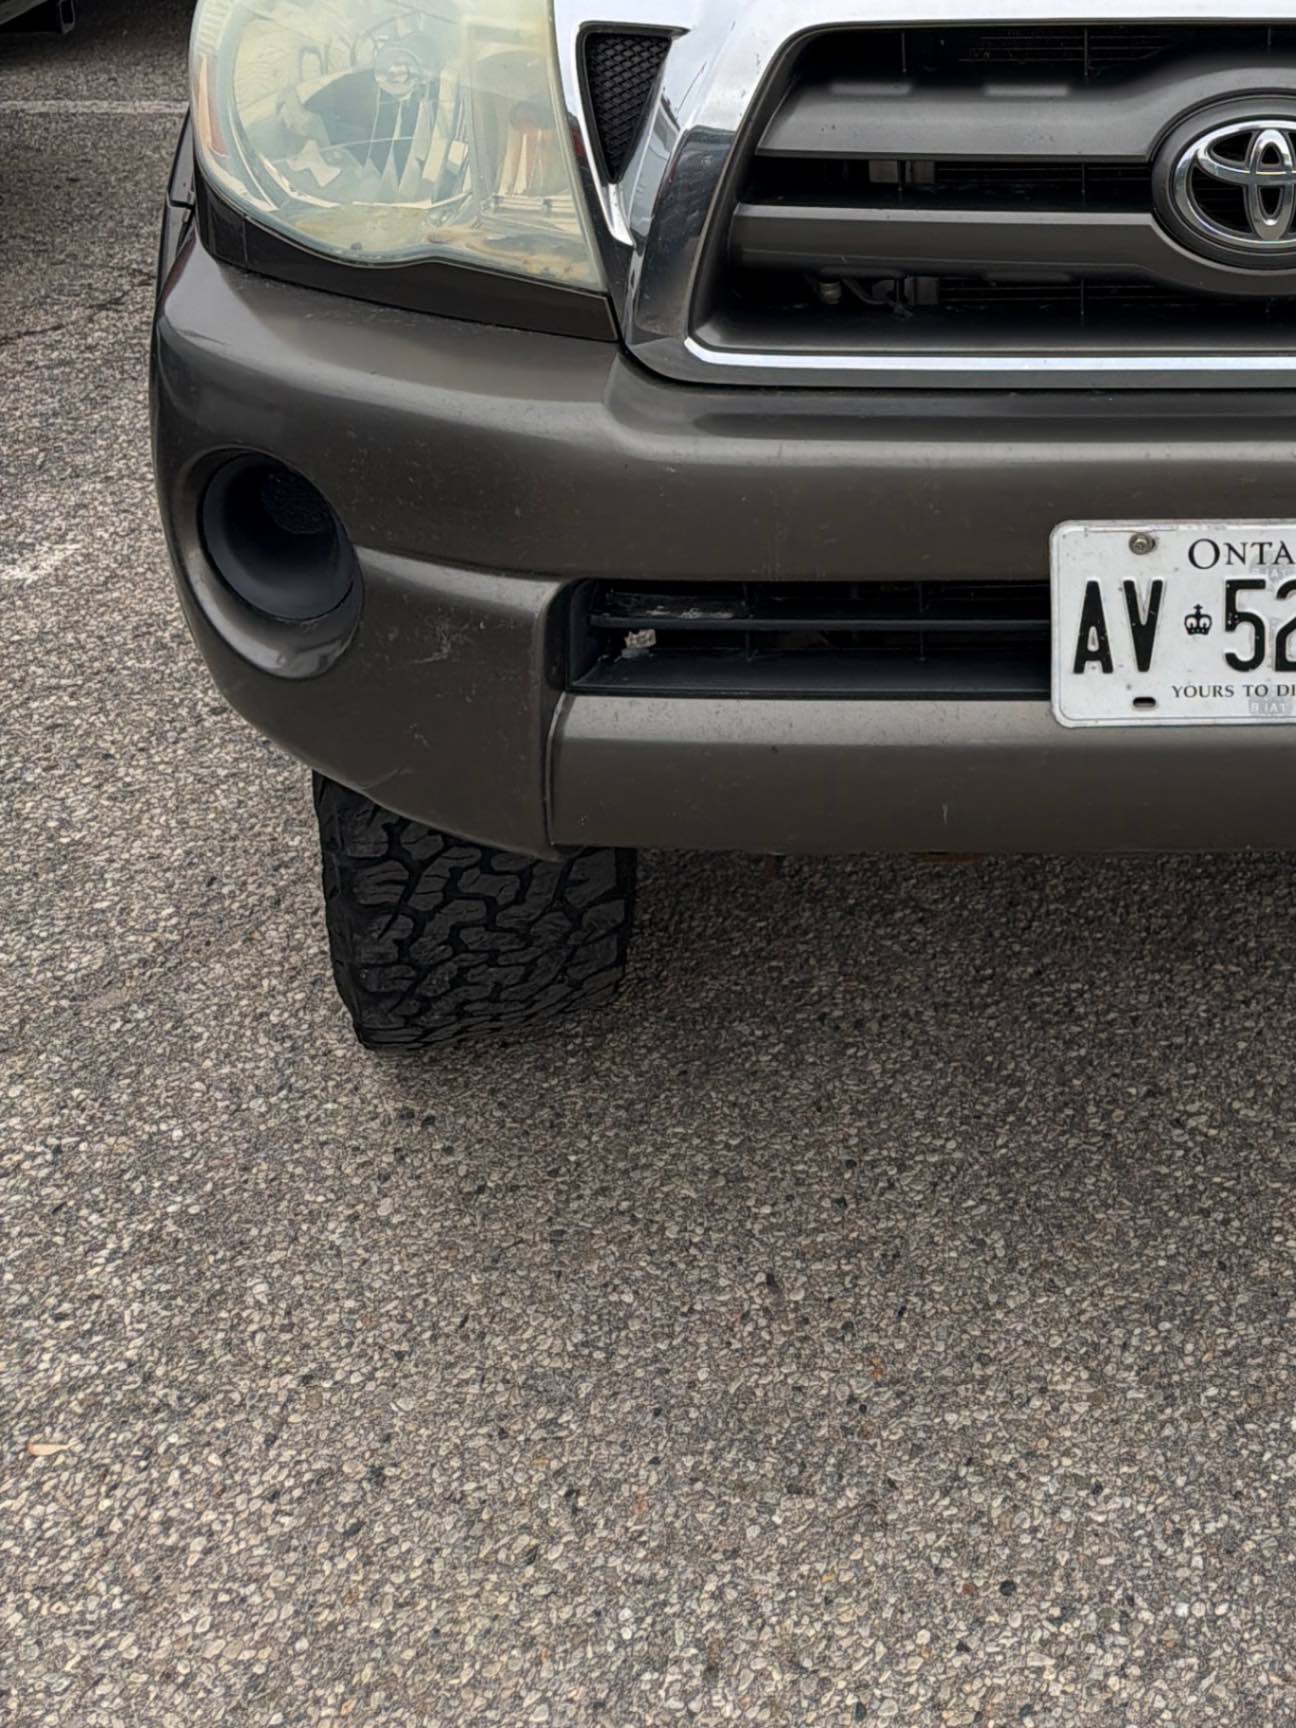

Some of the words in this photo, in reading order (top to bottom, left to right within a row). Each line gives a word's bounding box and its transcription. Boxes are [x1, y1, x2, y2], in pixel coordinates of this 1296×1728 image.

[1073, 578, 1164, 674] AV
[1171, 684, 1235, 698] YOURS
[1243, 684, 1269, 697] TO
